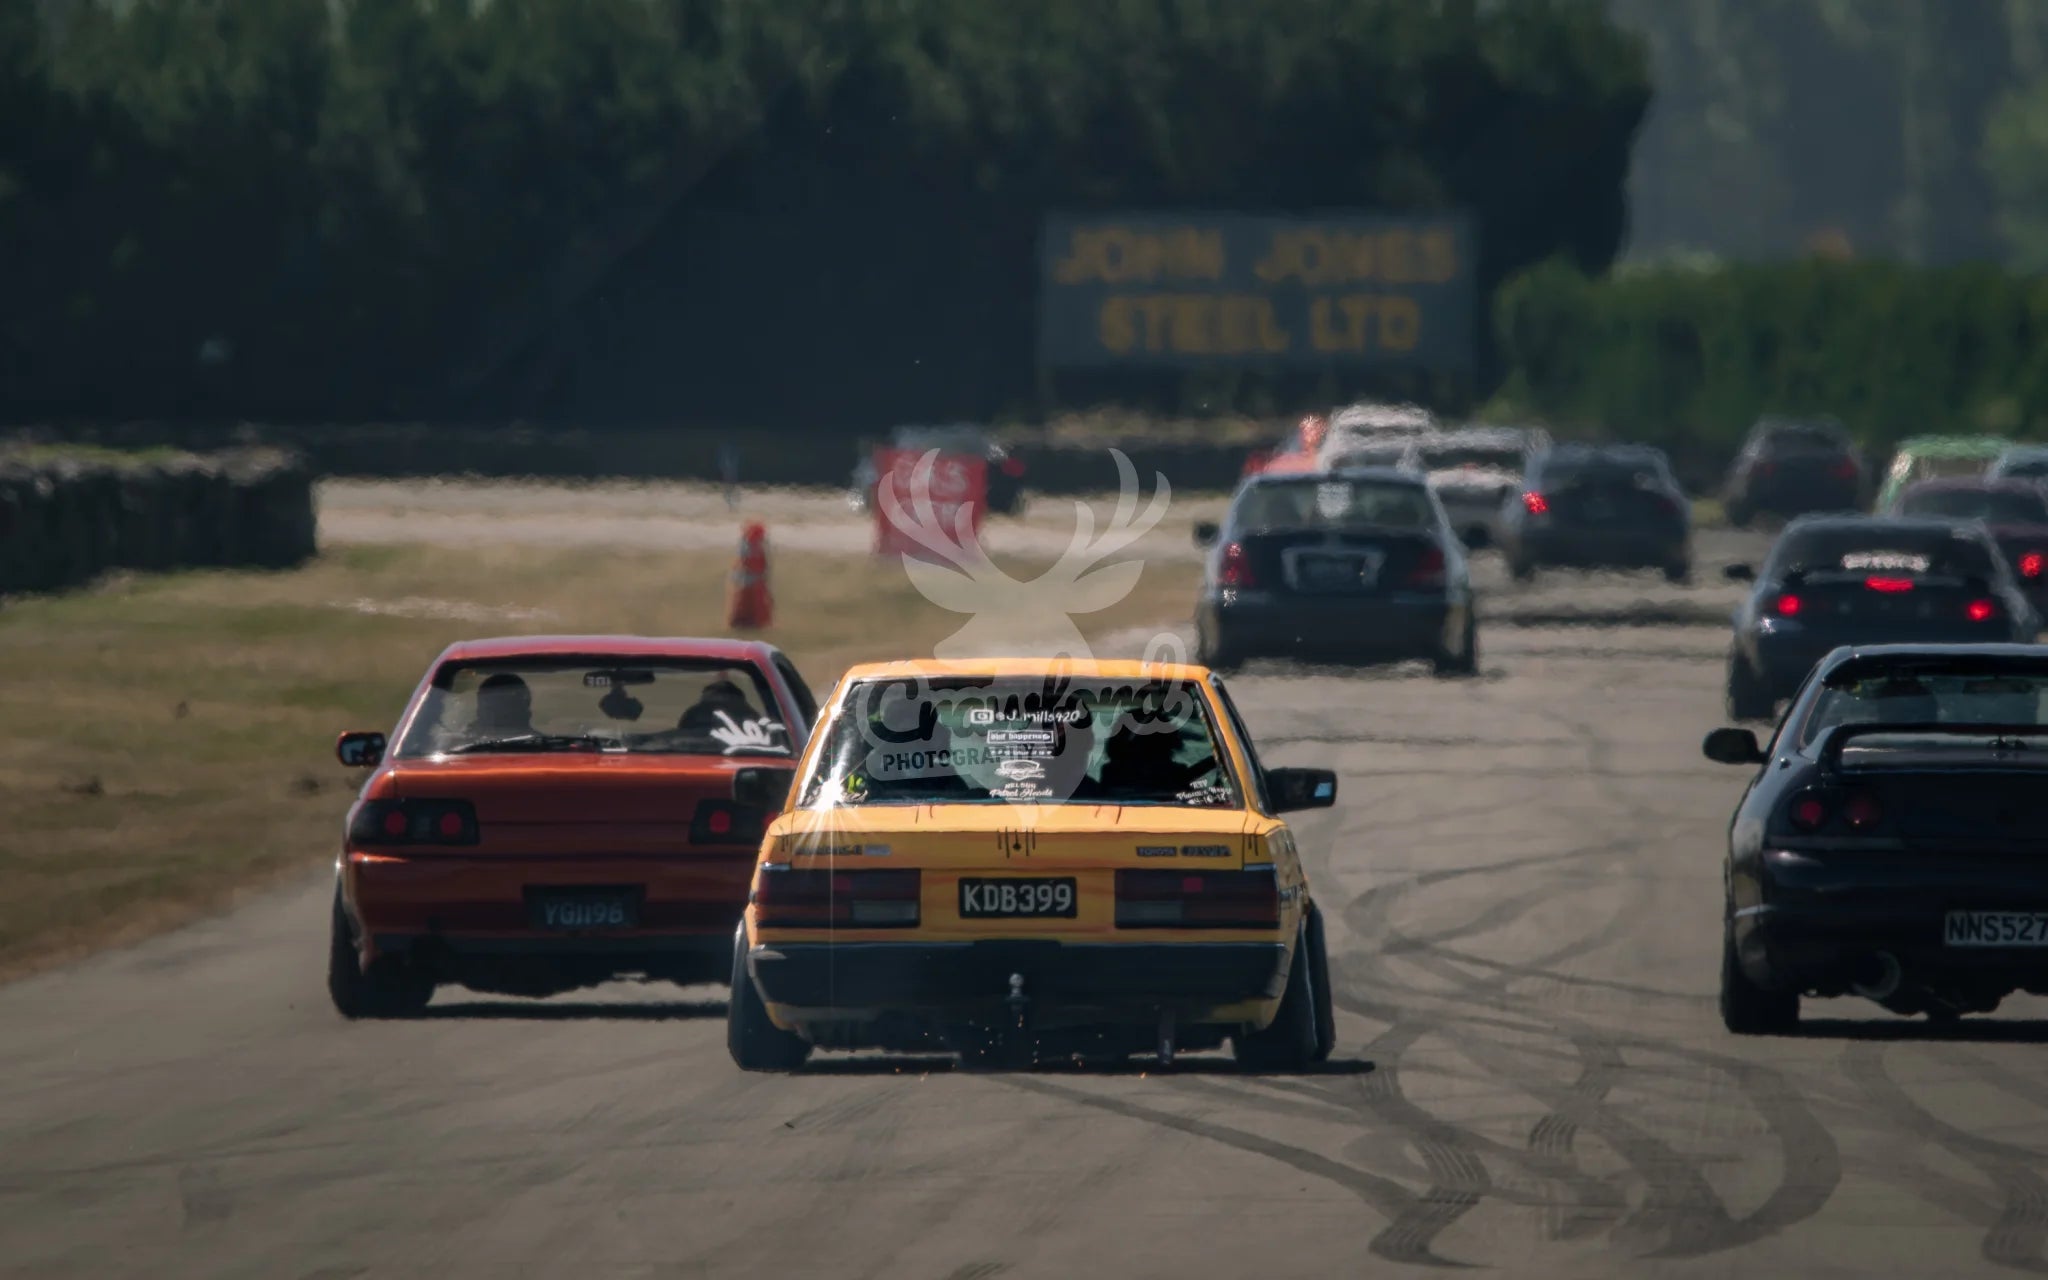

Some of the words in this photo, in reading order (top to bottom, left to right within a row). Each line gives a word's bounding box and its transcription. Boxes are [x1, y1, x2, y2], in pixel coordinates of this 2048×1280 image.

[1054, 226, 1223, 284] JOHN
[1253, 227, 1456, 284] JONES
[1100, 294, 1291, 353] STEEL
[1310, 295, 1420, 352] LTD
[964, 884, 1072, 912] KDB399
[544, 901, 624, 925] YG1196
[1949, 915, 2048, 942] NNS527
